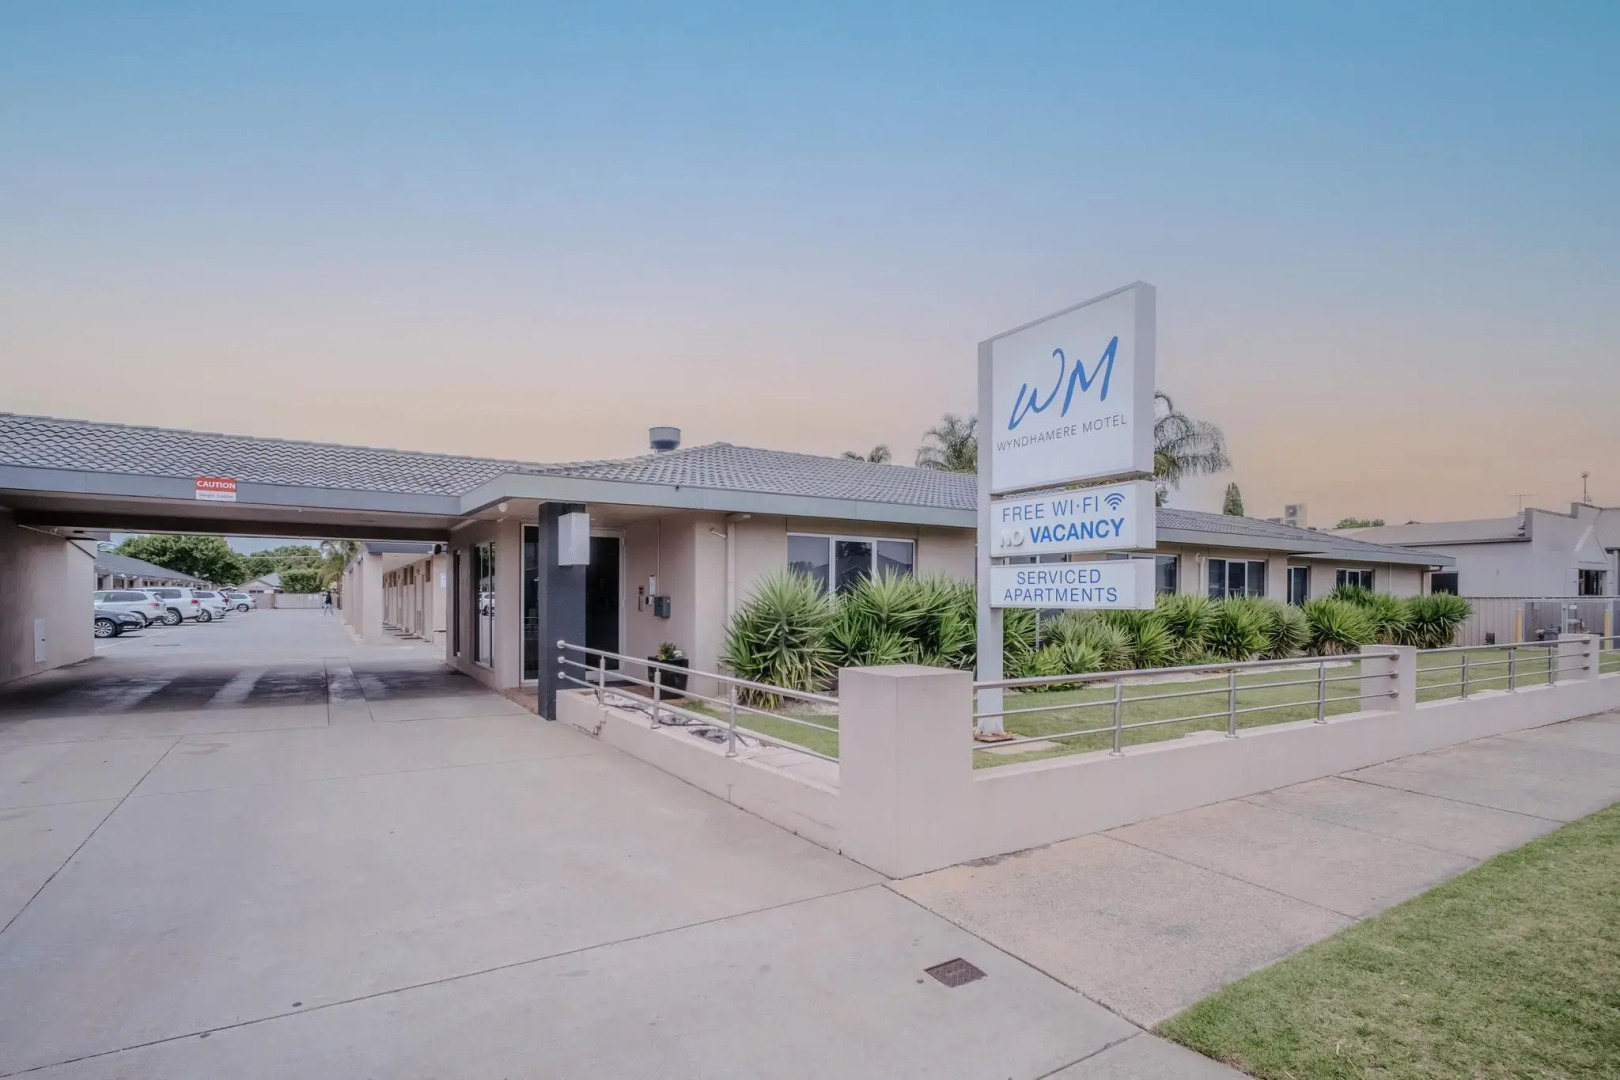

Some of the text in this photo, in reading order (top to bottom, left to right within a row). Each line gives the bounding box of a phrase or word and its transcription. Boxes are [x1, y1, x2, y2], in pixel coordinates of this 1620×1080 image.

[1008, 335, 1119, 431] WM
[997, 414, 1127, 452] WYNDHAMERE MOTEL
[196, 481, 236, 489] CAUTION
[1002, 503, 1044, 523] FREE
[1030, 517, 1125, 544] VACANCY
[1017, 569, 1101, 585] SERVICED
[1003, 587, 1118, 603] APARTMENTS
